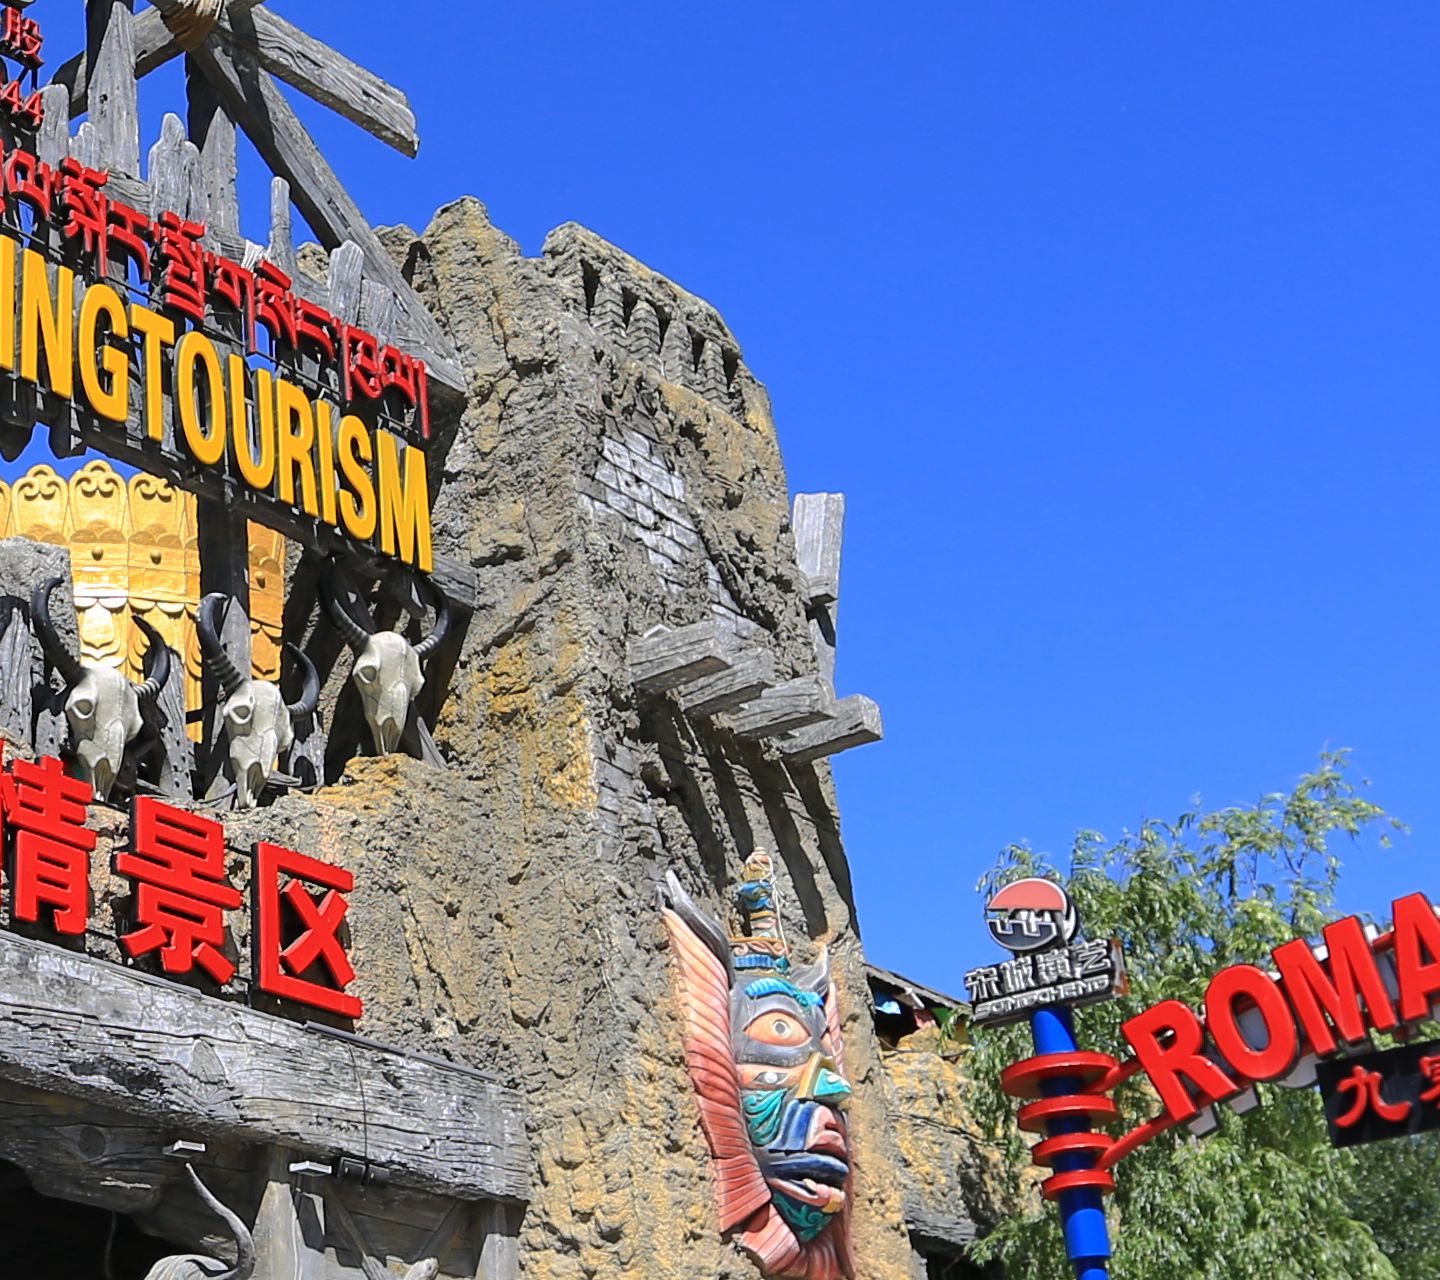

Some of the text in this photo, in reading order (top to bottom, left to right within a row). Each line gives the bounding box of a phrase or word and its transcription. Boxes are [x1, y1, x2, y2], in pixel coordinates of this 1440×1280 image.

[964, 938, 1112, 1003] 宋城演艺
[973, 974, 1110, 1020] SONGCHENG
